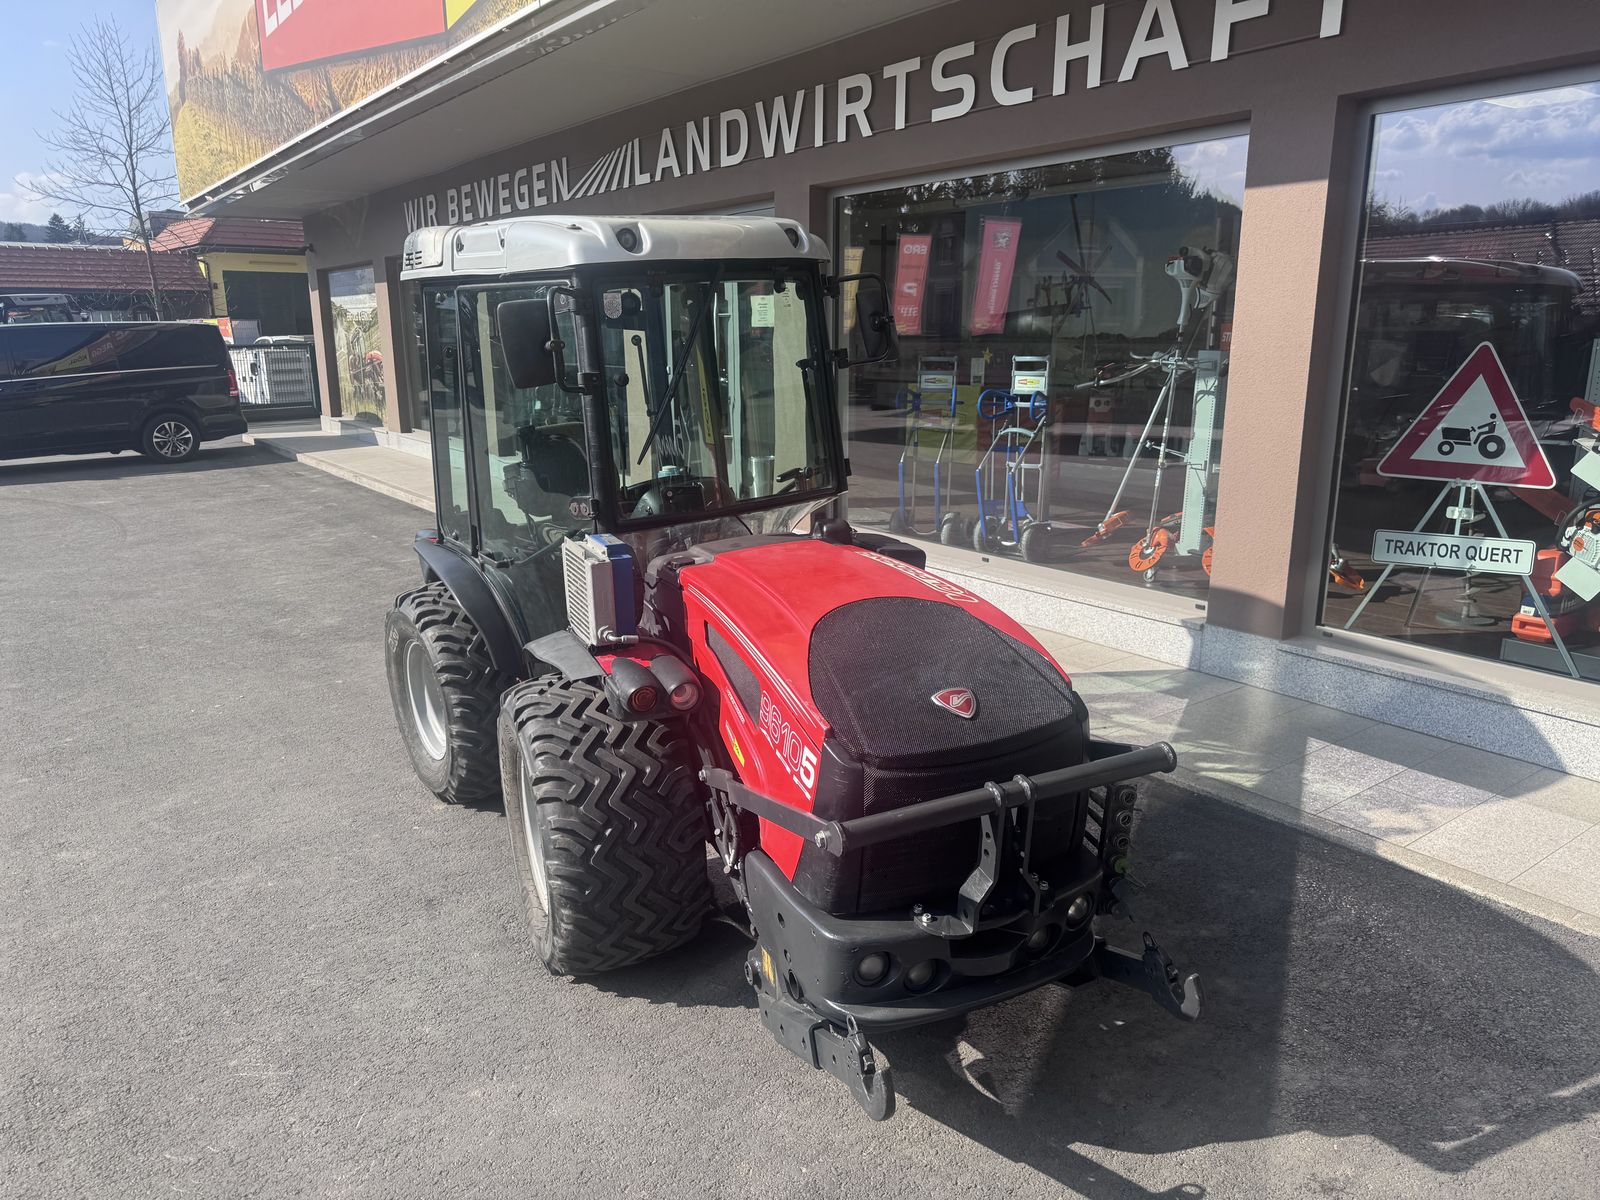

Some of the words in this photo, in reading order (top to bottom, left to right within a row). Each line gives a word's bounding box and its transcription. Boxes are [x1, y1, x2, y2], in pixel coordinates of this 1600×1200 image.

[403, 194, 437, 233] WIR
[447, 157, 569, 225] BEWEGEN
[1384, 538, 1461, 560] TRAKTOR
[1465, 545, 1523, 565] QUERT
